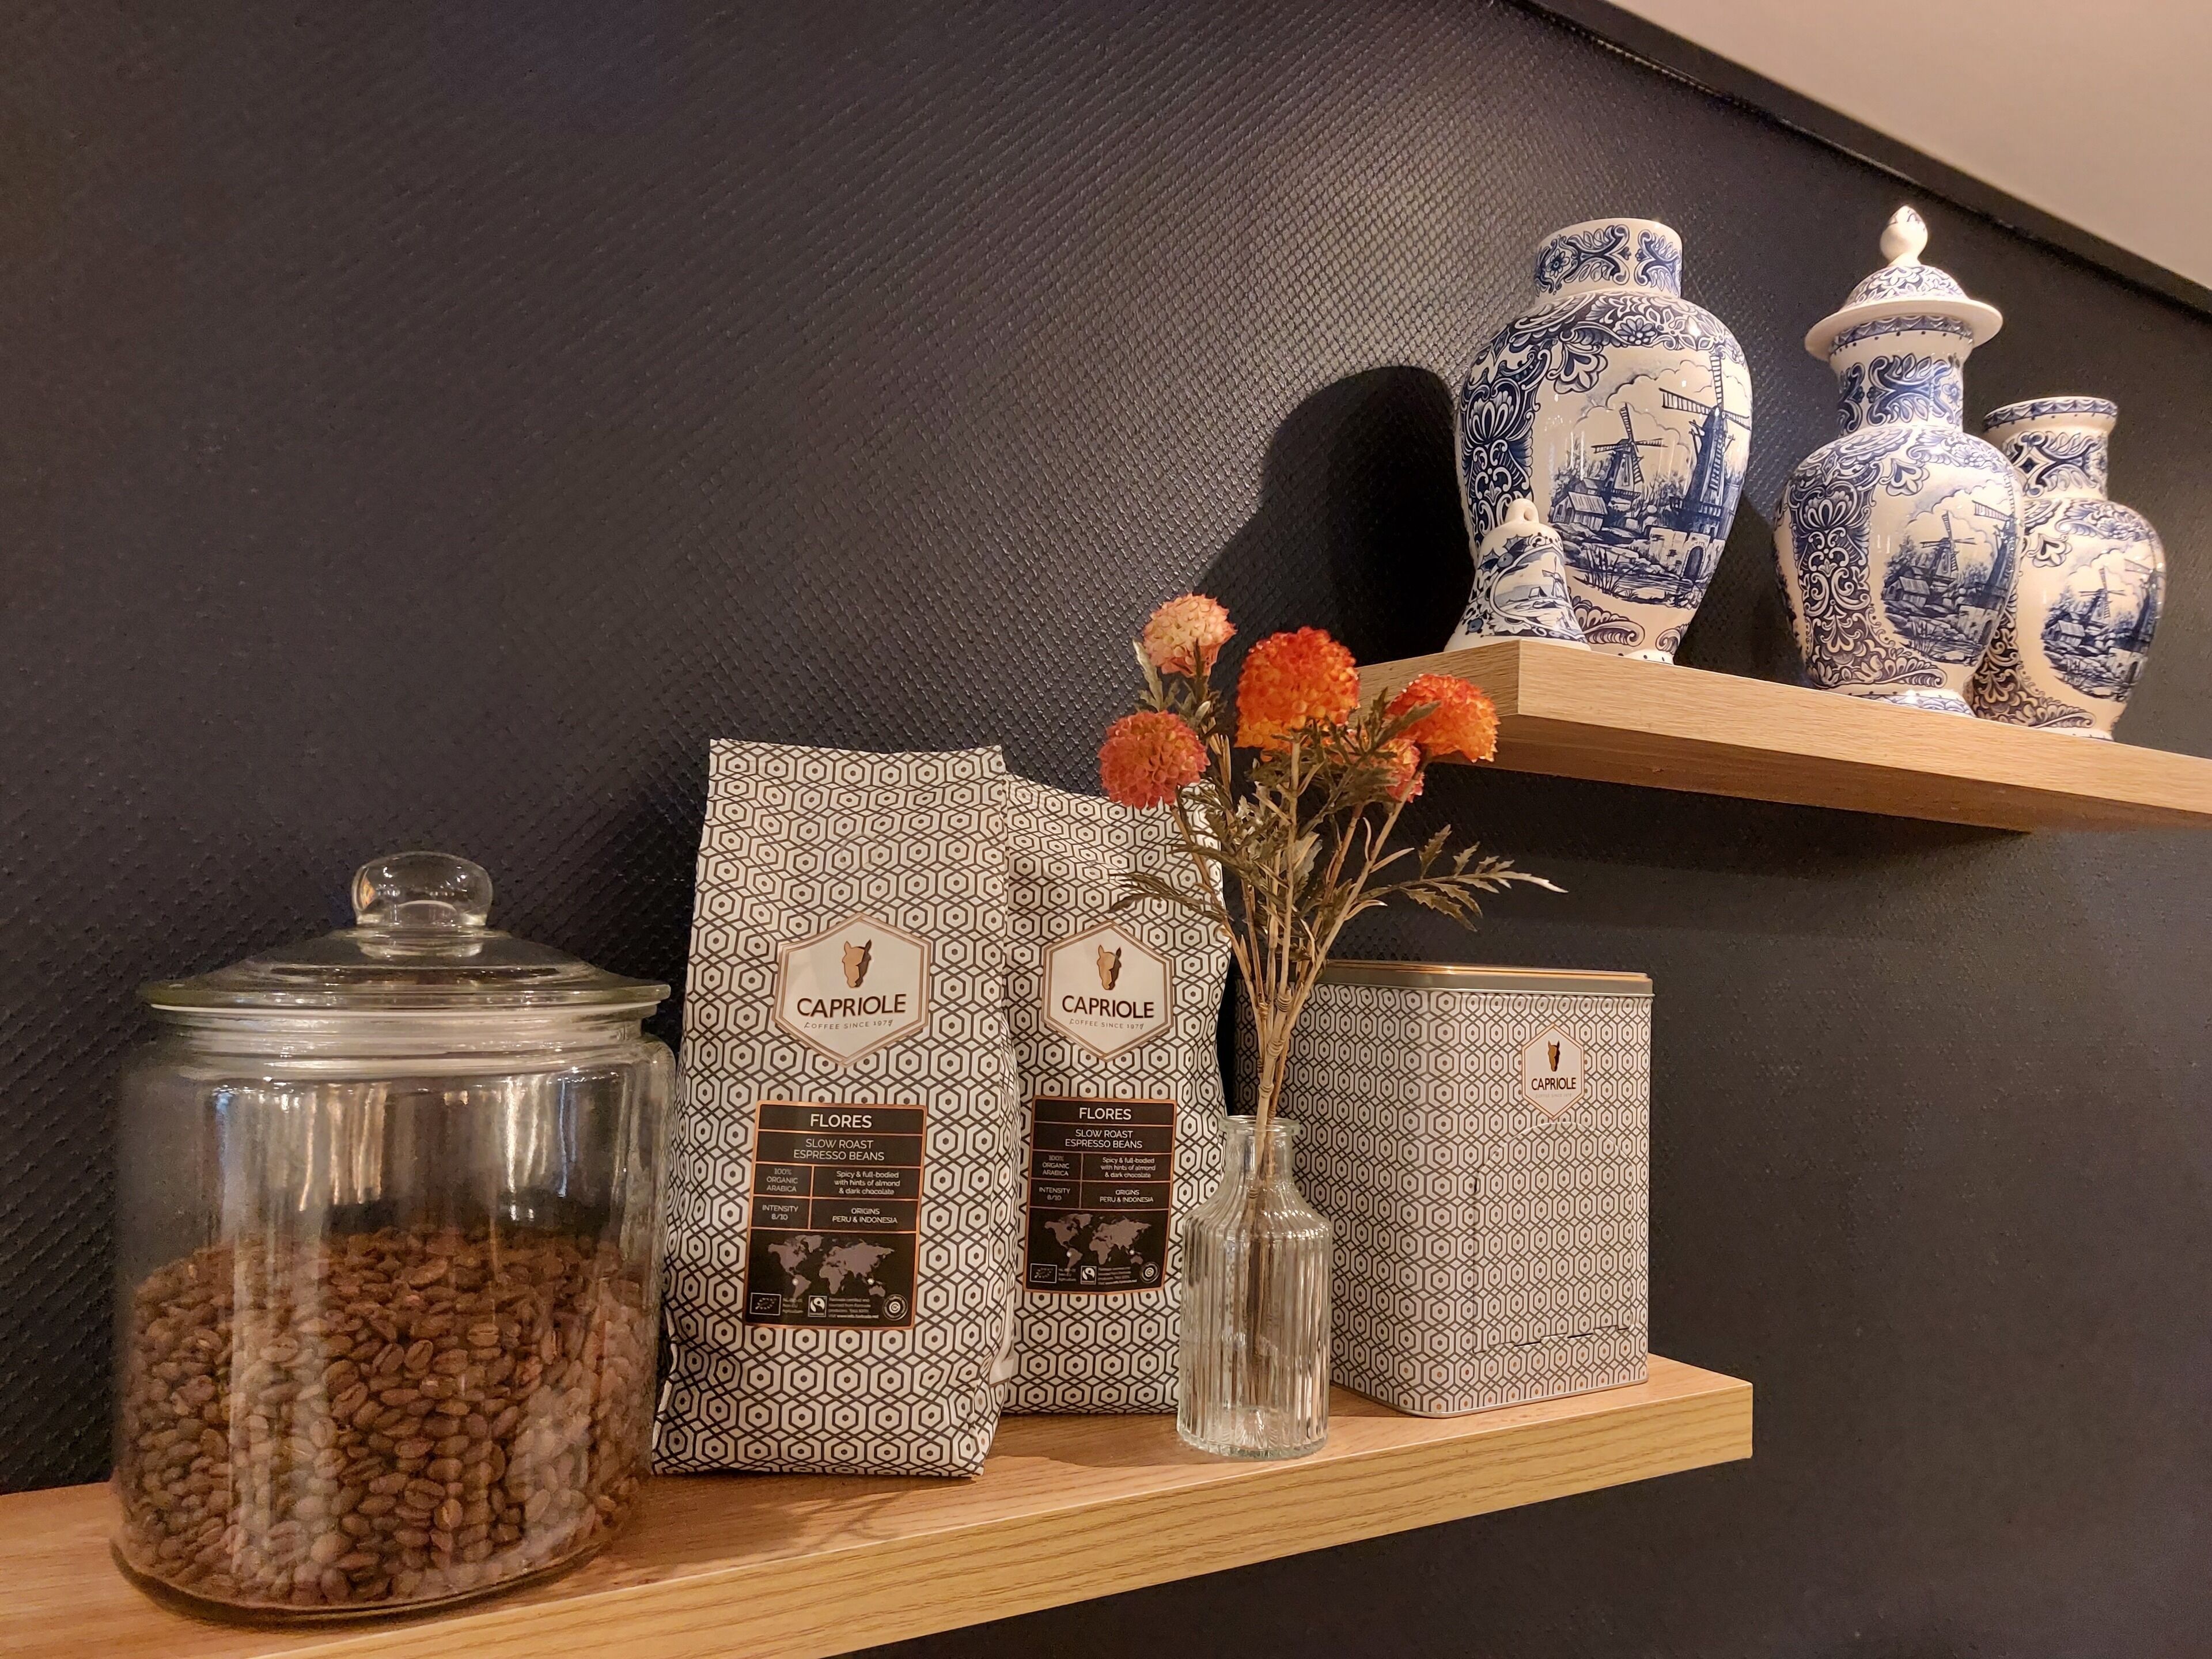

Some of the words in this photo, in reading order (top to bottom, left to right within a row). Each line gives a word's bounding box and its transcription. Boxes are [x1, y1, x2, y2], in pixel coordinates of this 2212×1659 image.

[797, 994, 906, 1018] CAPRIOLE
[1062, 995, 1154, 1018] CAPRIOLE
[1069, 1018, 1098, 1027] COFFEE
[1532, 1078, 1576, 1090] CAPRIOLE
[1079, 1107, 1131, 1120] FLORES
[810, 1113, 872, 1128] FLORES
[1075, 1129, 1102, 1138] SLOW
[1104, 1130, 1133, 1138] ROAST
[806, 1139, 836, 1148] SLOW
[839, 1140, 874, 1149] ROAST
[1065, 1139, 1110, 1147] ESPRESSO
[793, 1150, 846, 1160] ESPRESSO
[849, 1152, 884, 1161] BEANS
[767, 1176, 798, 1184] ORGANIC
